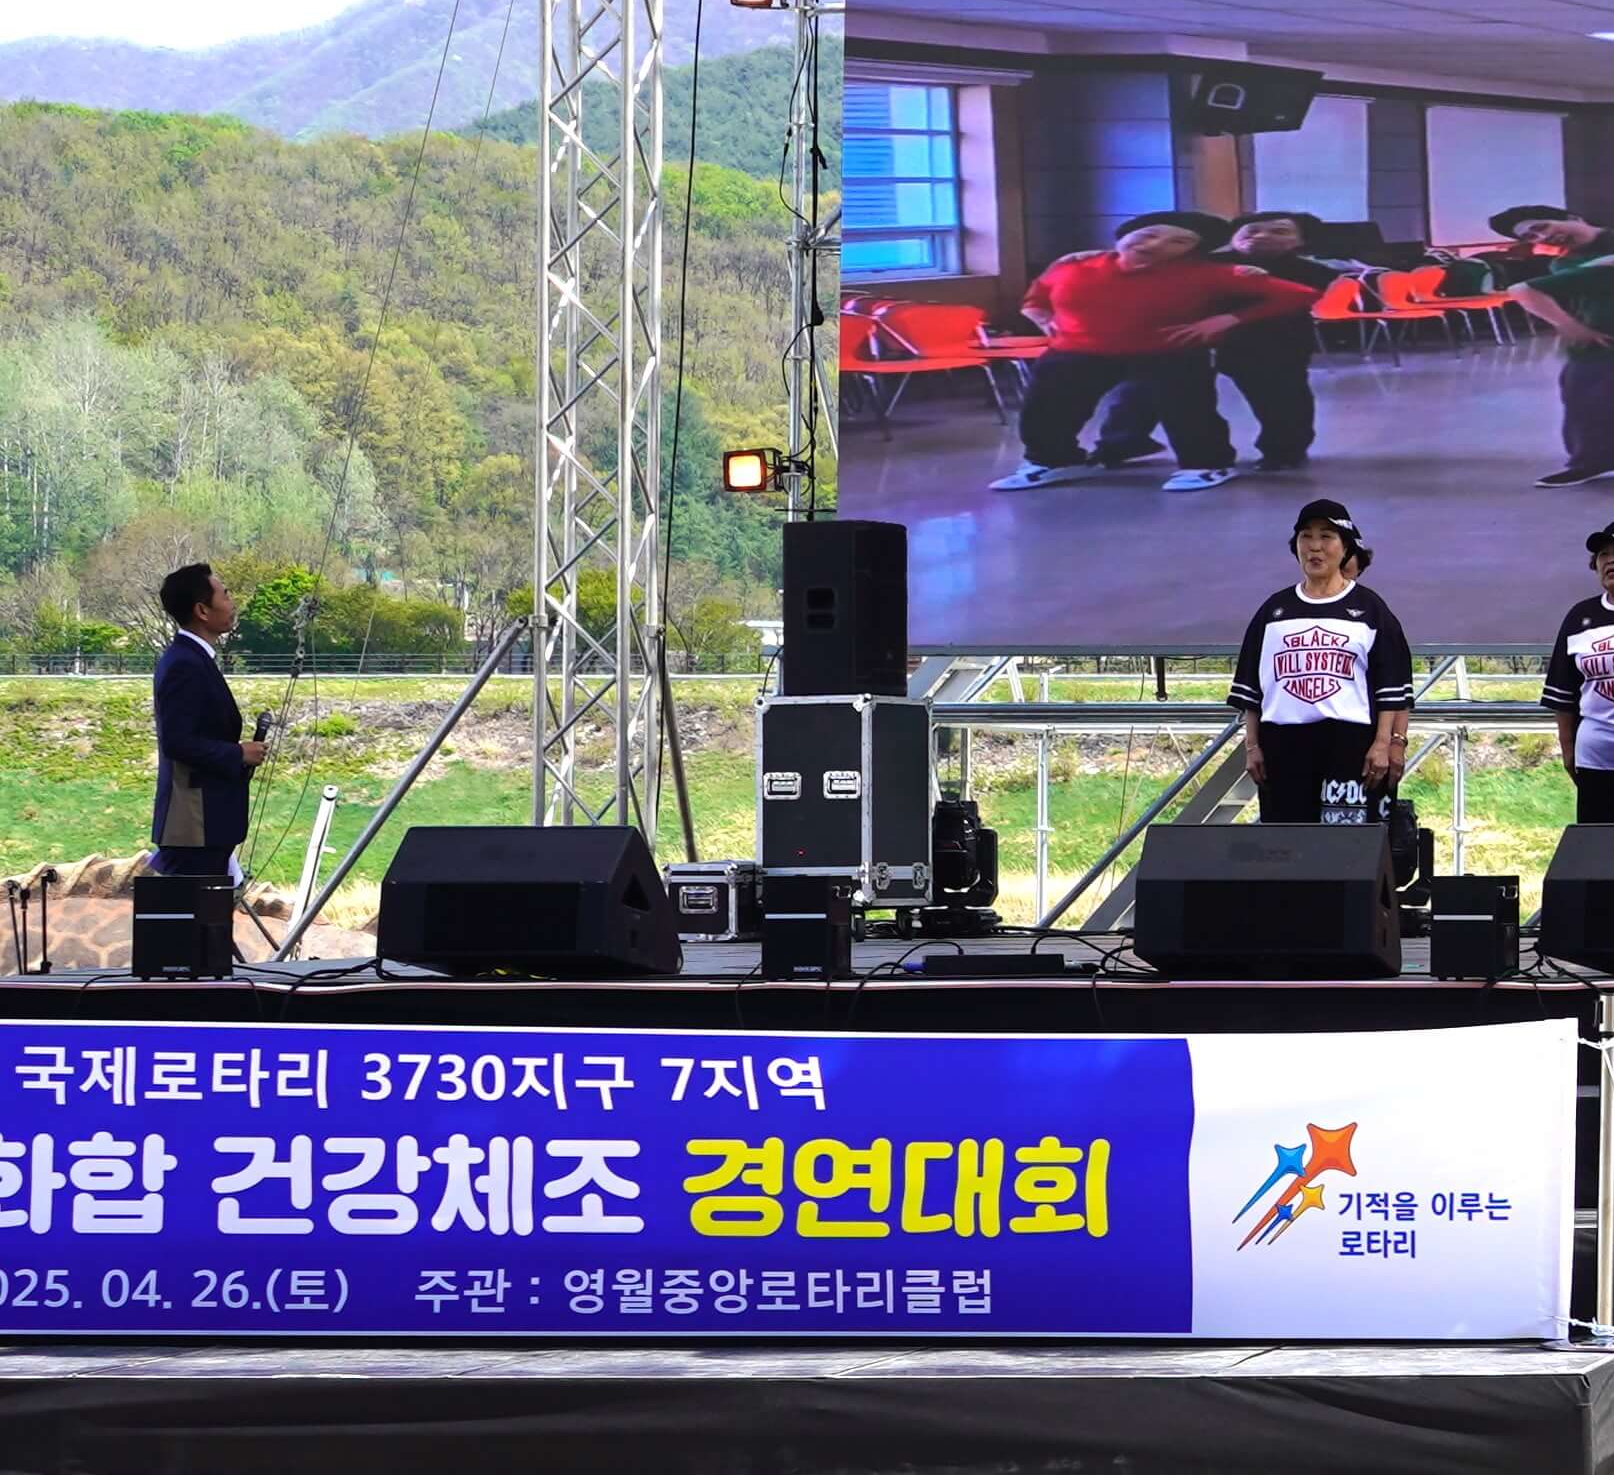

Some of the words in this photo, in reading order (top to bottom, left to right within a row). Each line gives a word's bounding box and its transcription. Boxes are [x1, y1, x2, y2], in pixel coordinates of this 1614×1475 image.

[1291, 630, 1340, 647] BLACK
[1306, 652, 1353, 676] SYSTEM
[1583, 657, 1609, 678] KILL
[1291, 678, 1335, 700] ANGELS
[16, 1047, 328, 1108] 국제로타리
[361, 1052, 635, 1110] 3730지구
[660, 1055, 826, 1111] 7지역
[211, 1133, 645, 1236] 건강체조
[682, 1135, 1111, 1238] 경연대회
[1339, 1191, 1419, 1222] 기적을
[1431, 1192, 1512, 1221] 이루는
[1338, 1229, 1416, 1259] 로타리
[102, 1269, 172, 1309] 04.
[191, 1268, 349, 1314] 26.(토)
[415, 1268, 512, 1313] 주관
[564, 1268, 991, 1314] 영월중앙로타리클럽
